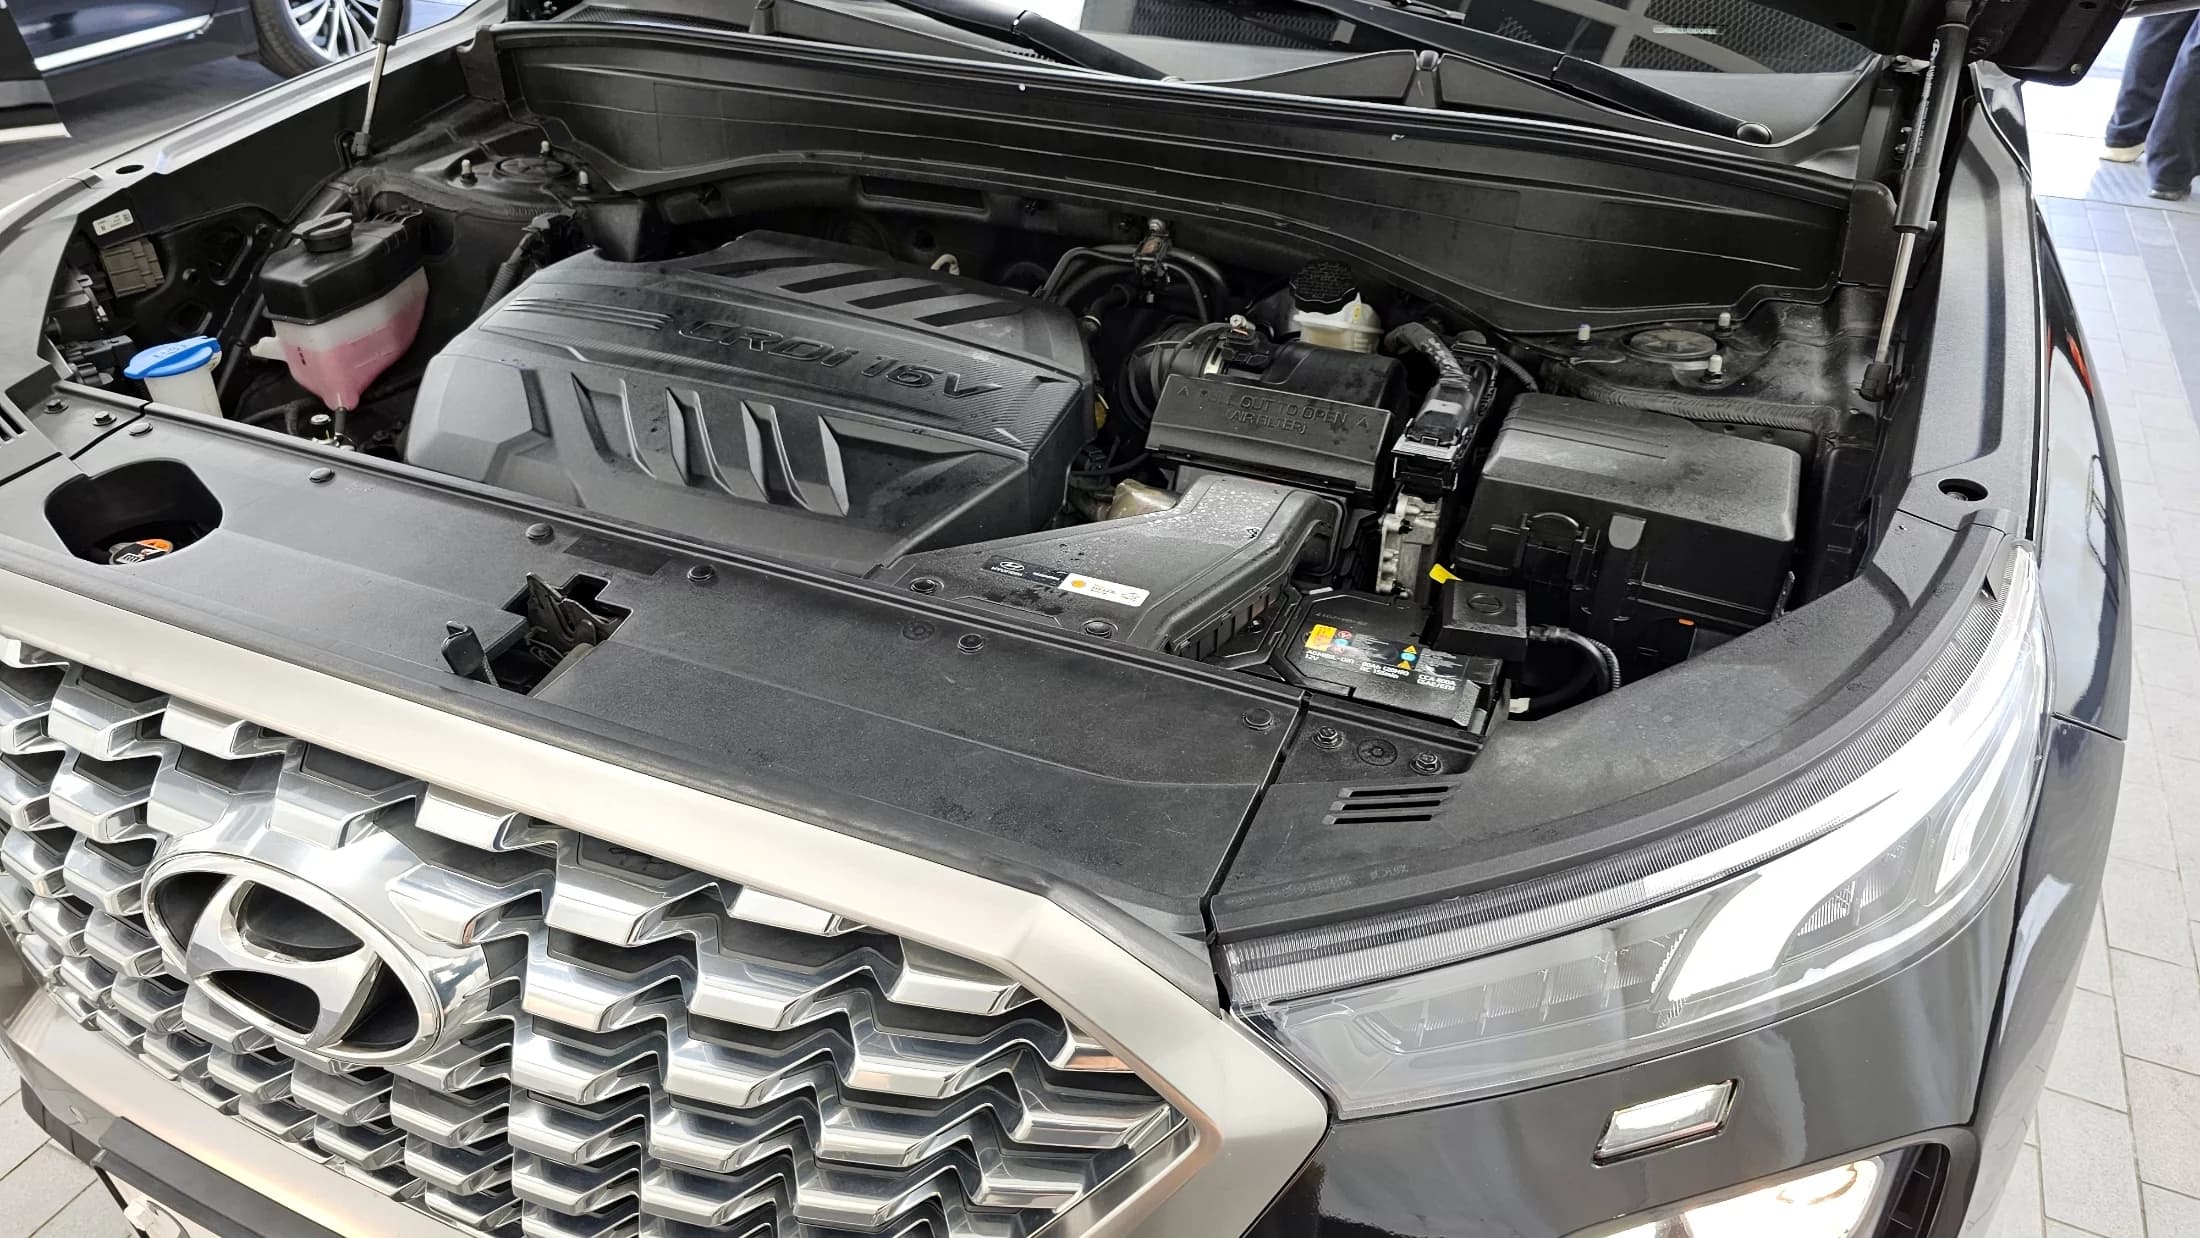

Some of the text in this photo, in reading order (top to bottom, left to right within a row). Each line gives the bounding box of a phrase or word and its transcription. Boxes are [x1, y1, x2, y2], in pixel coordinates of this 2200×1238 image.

[861, 355, 1004, 399] 16V
[1239, 394, 1275, 411] OUT
[1279, 401, 1298, 417] TO
[1301, 405, 1348, 426] OPEN
